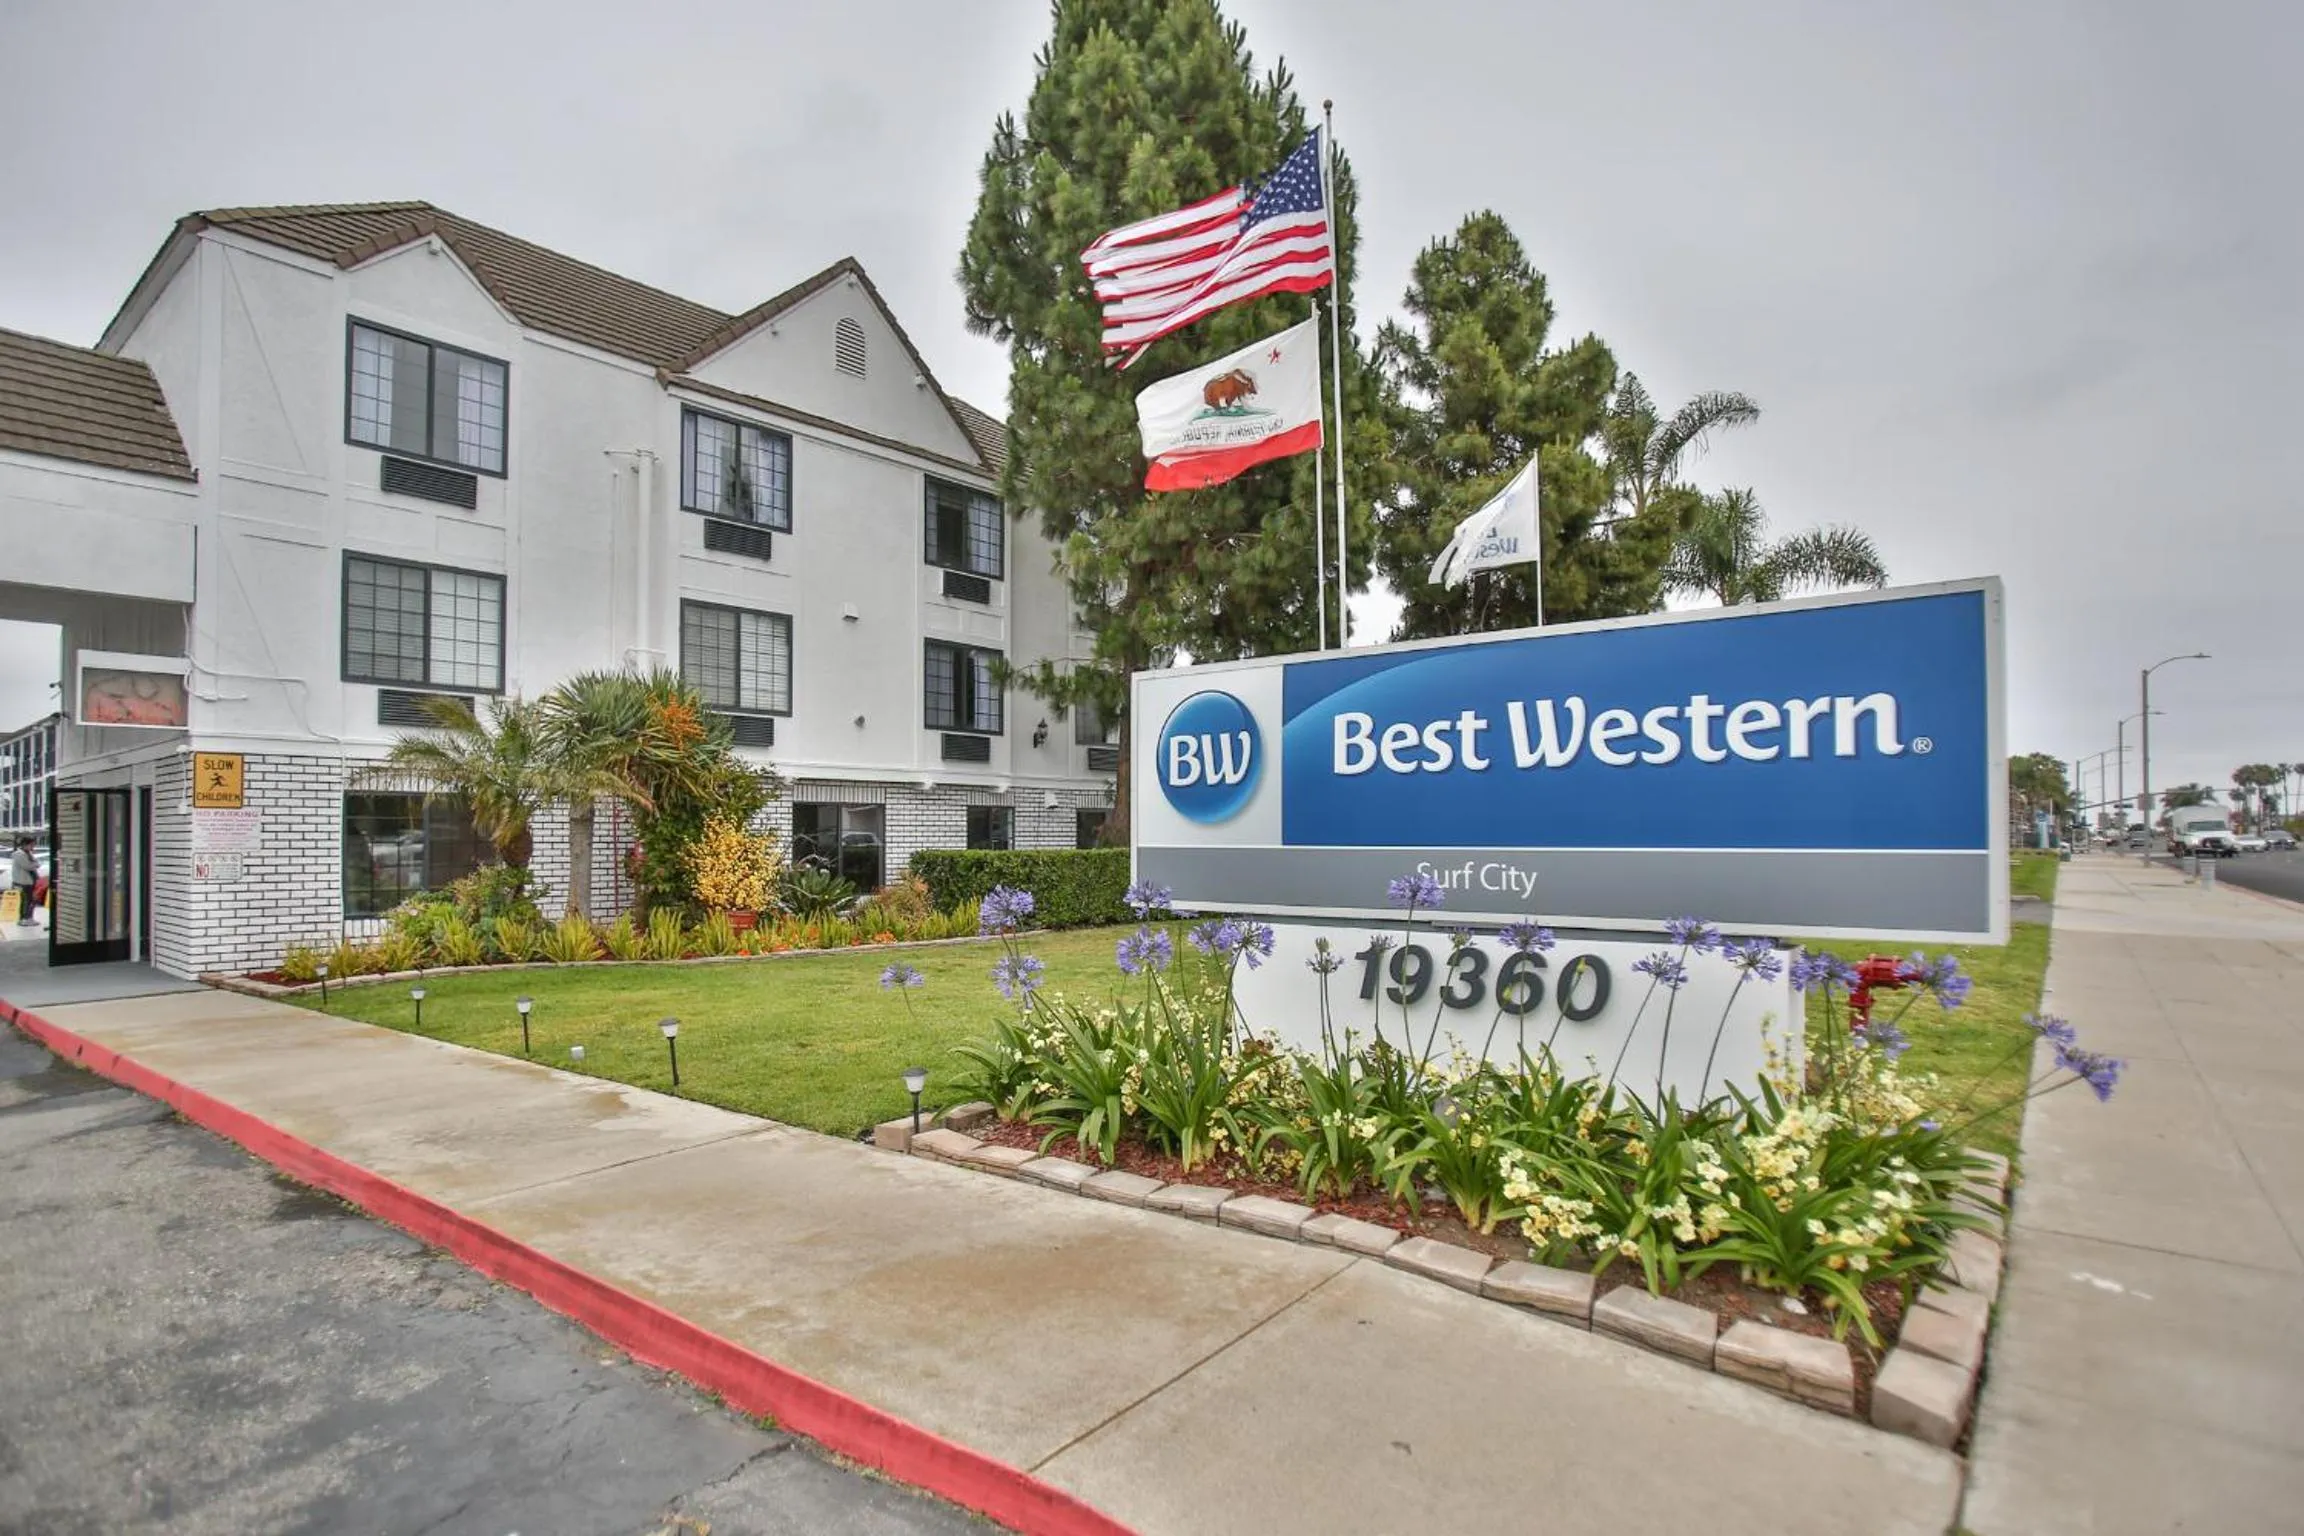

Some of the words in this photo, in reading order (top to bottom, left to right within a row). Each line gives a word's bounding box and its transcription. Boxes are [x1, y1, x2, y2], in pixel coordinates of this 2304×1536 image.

[1168, 730, 1252, 788] BW
[1333, 710, 1491, 775] Best
[1507, 692, 1905, 769] Western
[203, 759, 235, 771] SLOW
[1480, 862, 1539, 899] City
[1353, 944, 1613, 1022] 19360
